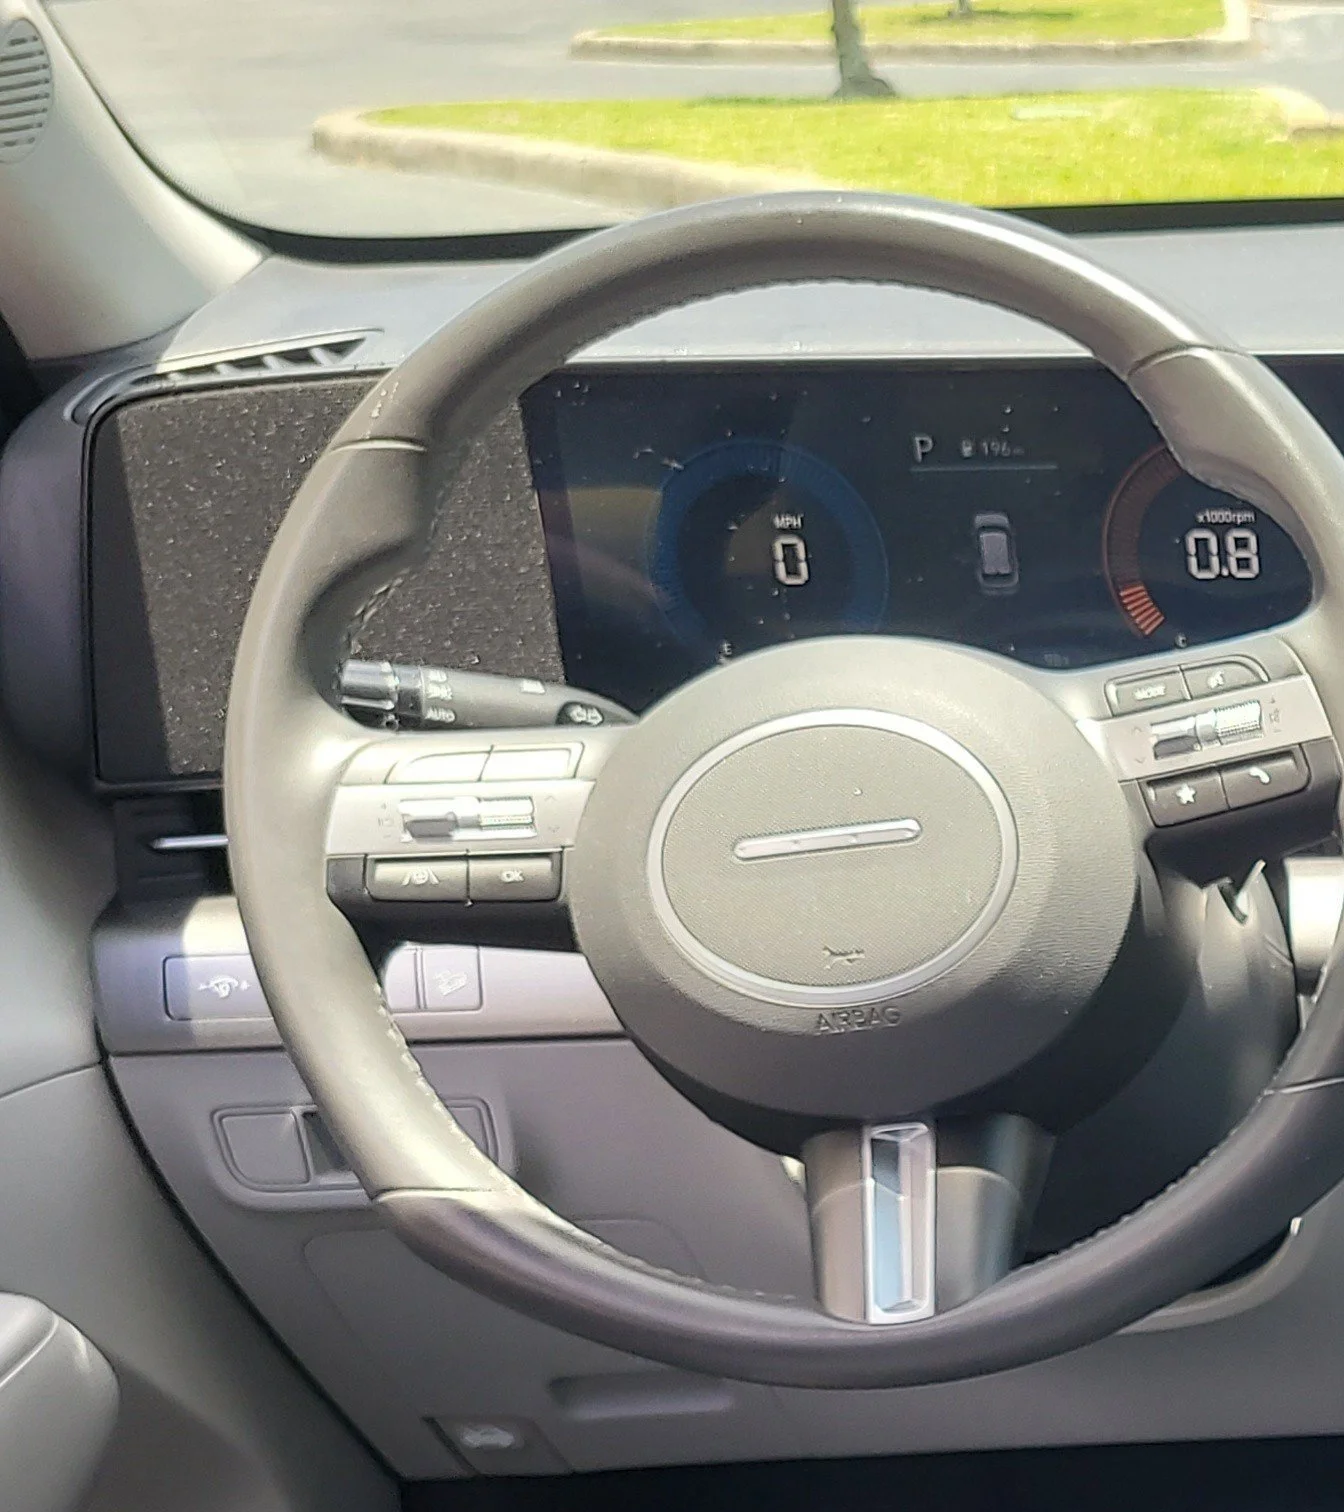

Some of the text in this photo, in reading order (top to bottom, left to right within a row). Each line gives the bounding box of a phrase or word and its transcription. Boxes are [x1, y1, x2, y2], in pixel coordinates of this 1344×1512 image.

[914, 434, 933, 463] P
[773, 513, 802, 529] MPH
[772, 534, 809, 585] 0
[1185, 528, 1260, 579] 0.8
[501, 869, 524, 882] OK
[816, 1005, 901, 1035] AIRBAG
